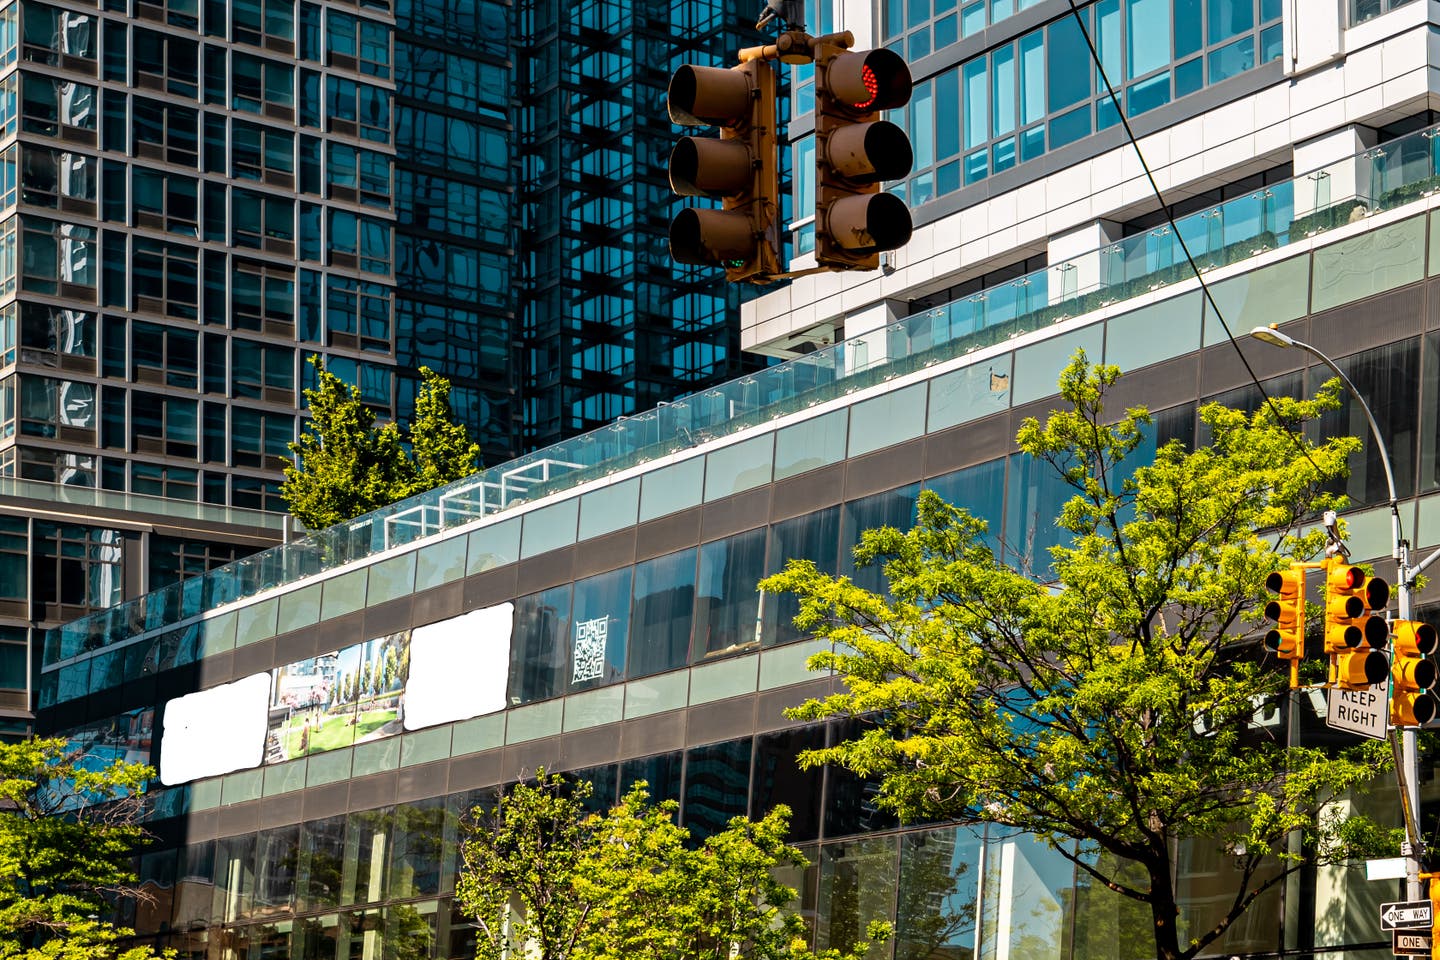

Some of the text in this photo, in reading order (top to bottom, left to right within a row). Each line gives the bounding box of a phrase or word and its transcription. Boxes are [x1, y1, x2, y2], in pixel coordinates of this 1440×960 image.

[1341, 689, 1376, 707] KEEP
[1338, 705, 1377, 727] RIGHT
[1388, 908, 1429, 921] ONE WAY
[1402, 937, 1421, 948] ONE
